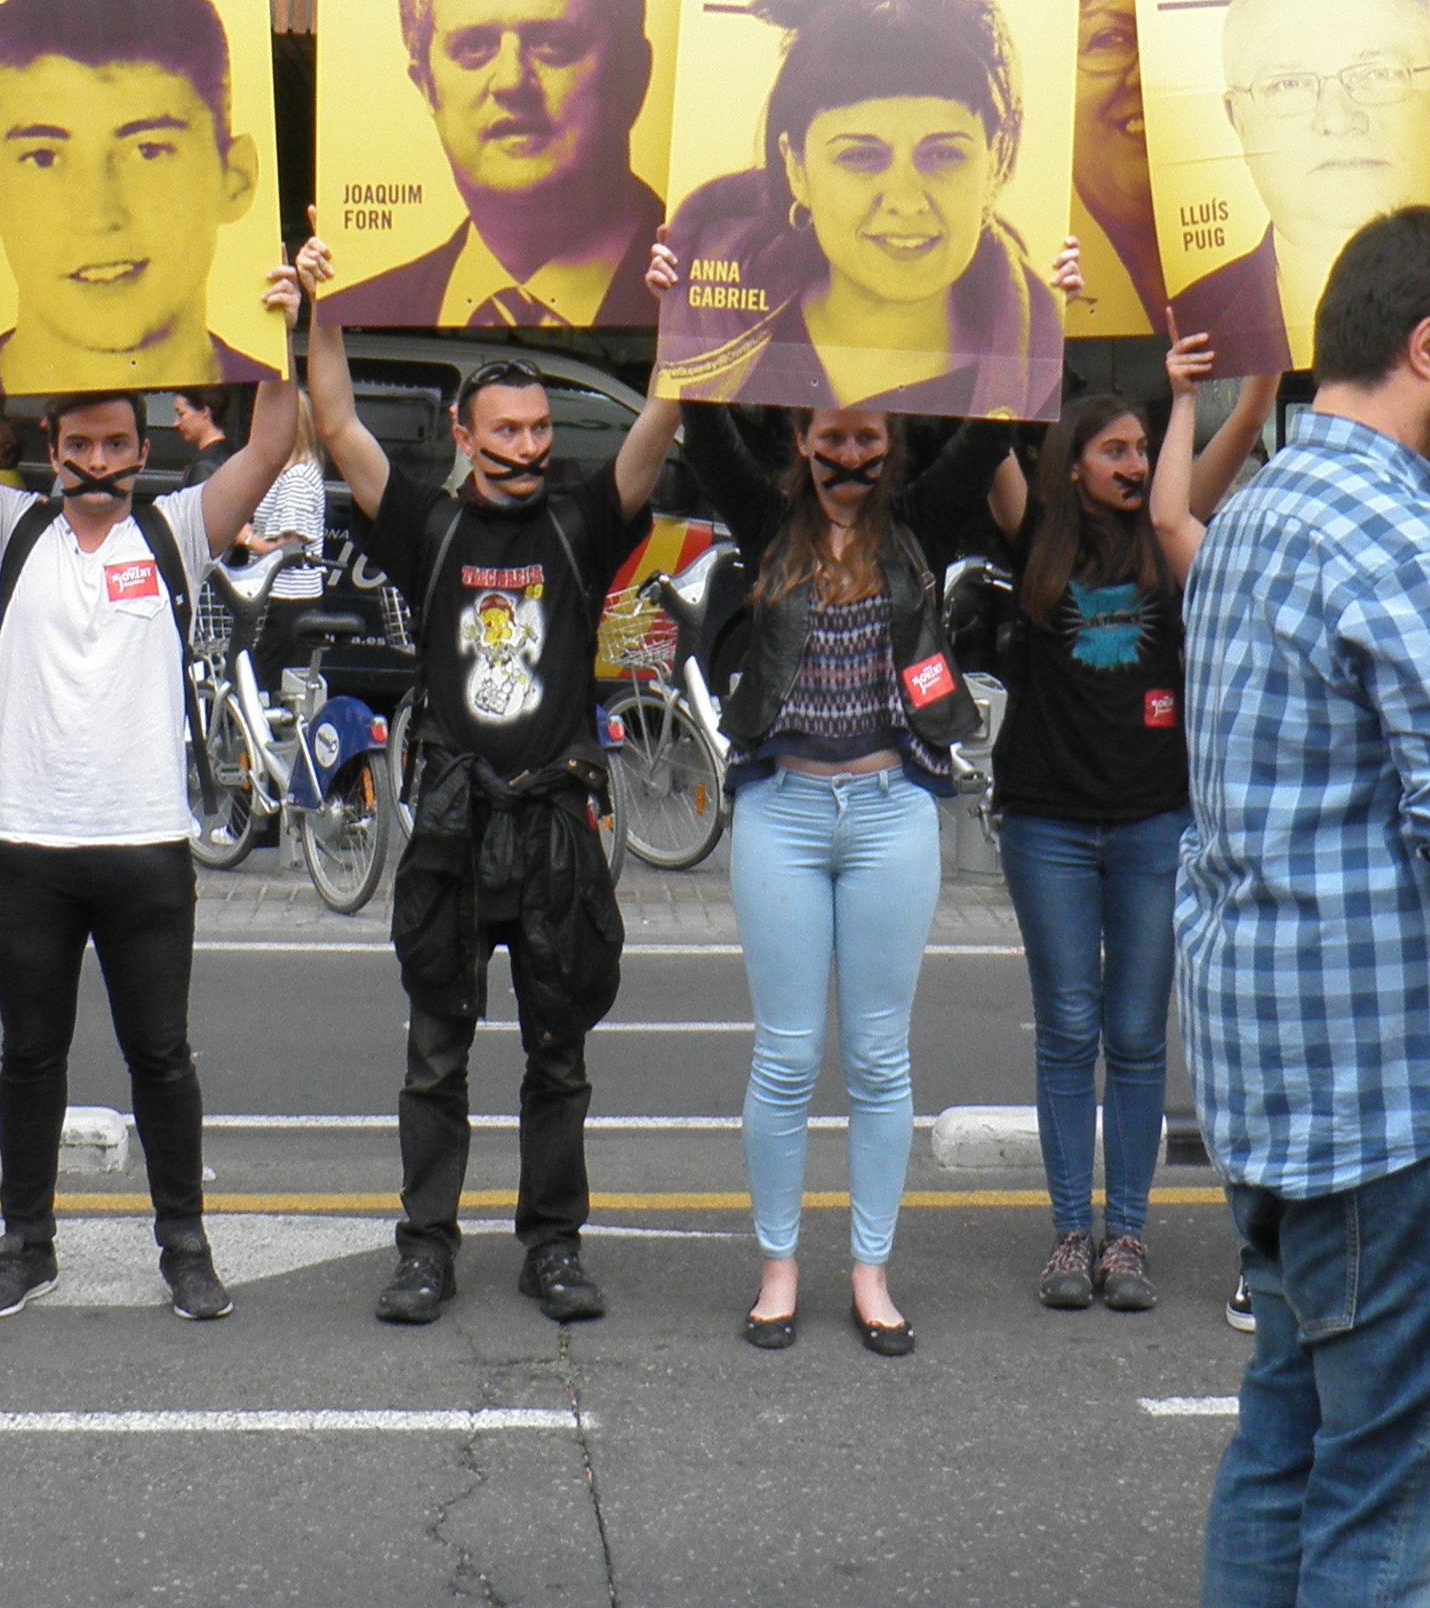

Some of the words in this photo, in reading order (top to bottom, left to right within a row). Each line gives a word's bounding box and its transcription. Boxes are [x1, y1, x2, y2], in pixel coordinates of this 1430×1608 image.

[343, 184, 423, 208] JOAQUIM
[344, 210, 393, 231] FORN
[1180, 199, 1230, 226] LLUÍS
[1183, 229, 1226, 251] PUIG
[690, 260, 740, 283] ANNA
[689, 286, 770, 312] GABRIEL
